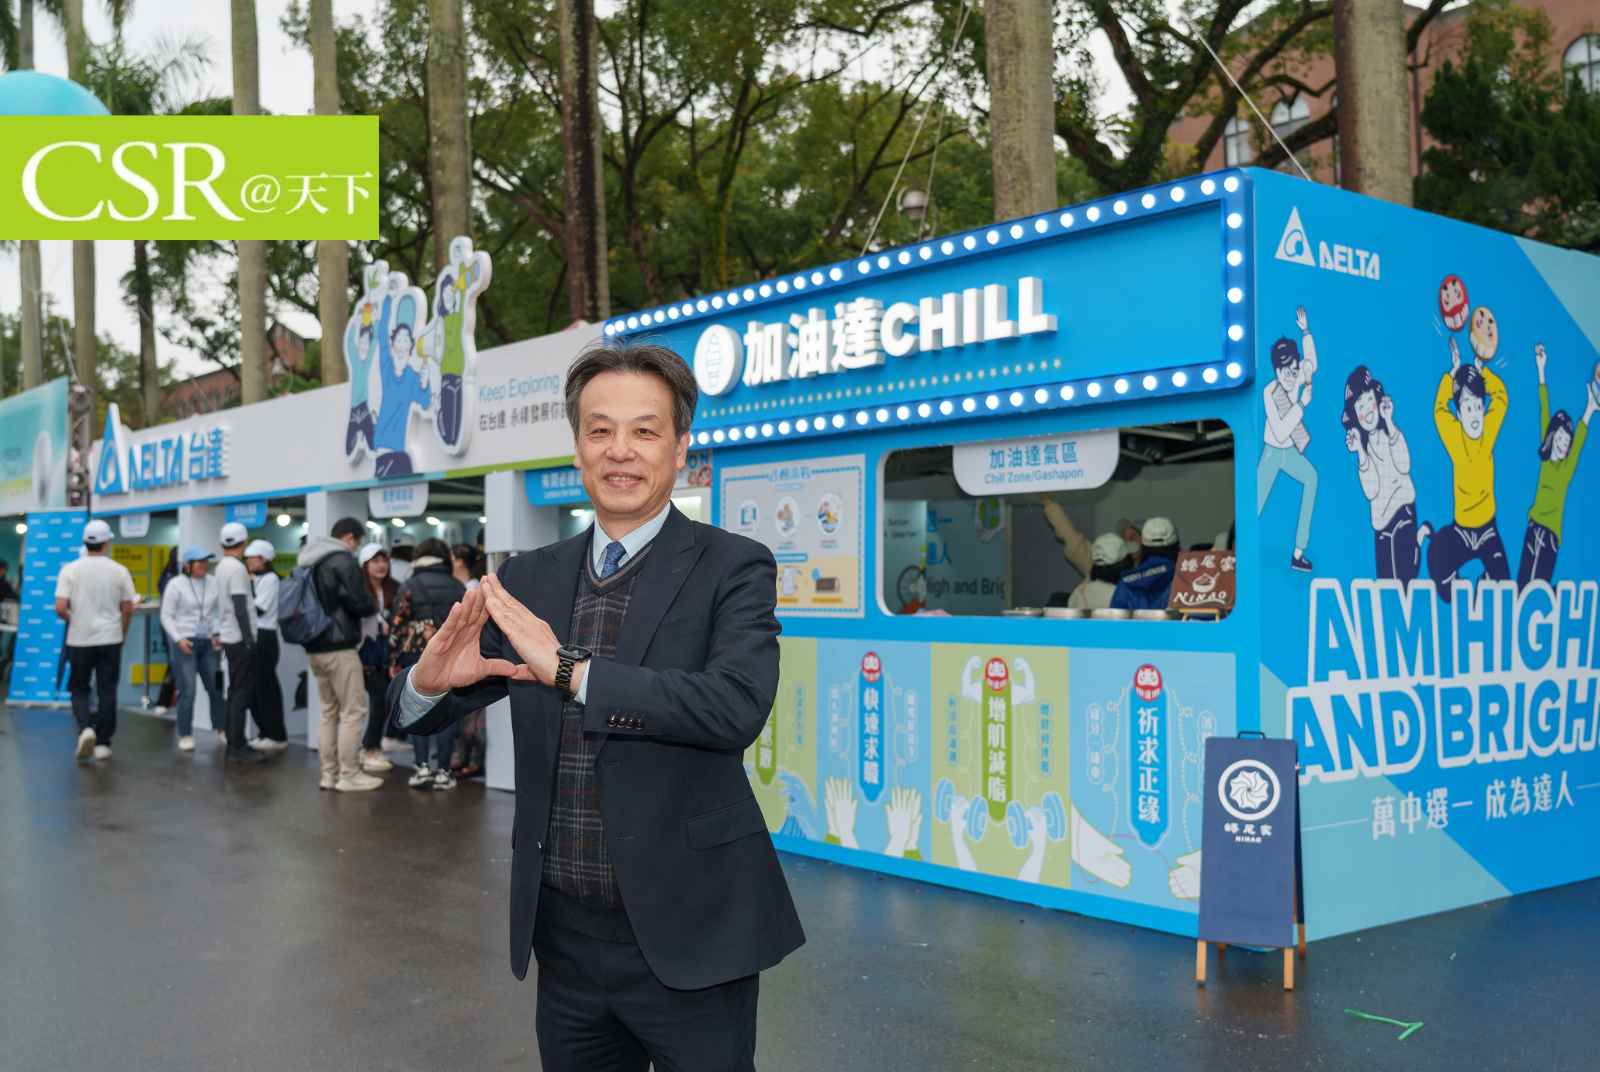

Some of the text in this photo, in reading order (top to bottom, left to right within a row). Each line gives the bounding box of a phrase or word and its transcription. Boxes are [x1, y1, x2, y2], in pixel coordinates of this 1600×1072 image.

[1319, 240, 1380, 281] DELTA
[741, 275, 1058, 388] 加油達CHILL
[479, 374, 560, 403] Keep Exploring
[128, 427, 225, 489] DELTA 台達
[984, 471, 1005, 484] Chill
[990, 441, 1077, 469] 加油達氣區
[954, 579, 977, 596] and
[1308, 578, 1599, 685] AIM HIGH
[1286, 677, 1600, 784] AND BRIGH
[1137, 706, 1160, 825] 祈求正緣
[1371, 770, 1575, 840] 萬中選一 成為達人
